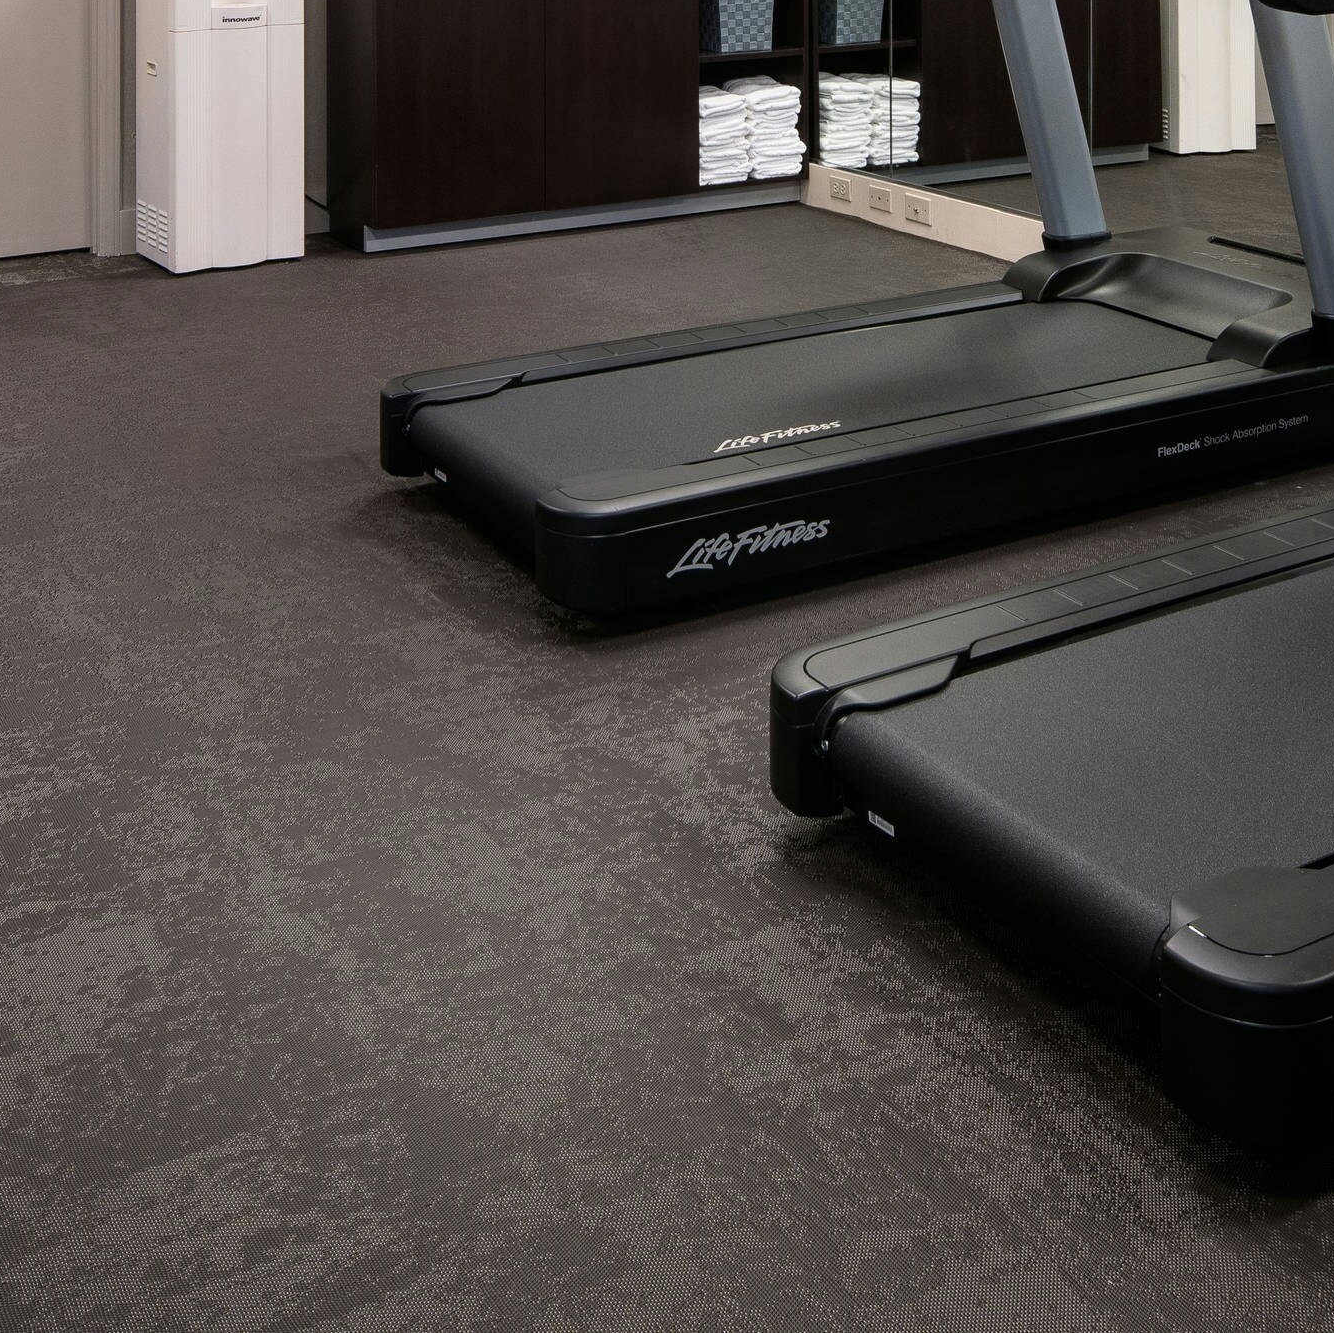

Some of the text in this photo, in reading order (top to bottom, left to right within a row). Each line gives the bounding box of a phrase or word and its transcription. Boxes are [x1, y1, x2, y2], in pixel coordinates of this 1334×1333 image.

[1203, 433, 1230, 447] Shock
[1232, 422, 1277, 441] Absorption
[1278, 414, 1309, 433] System
